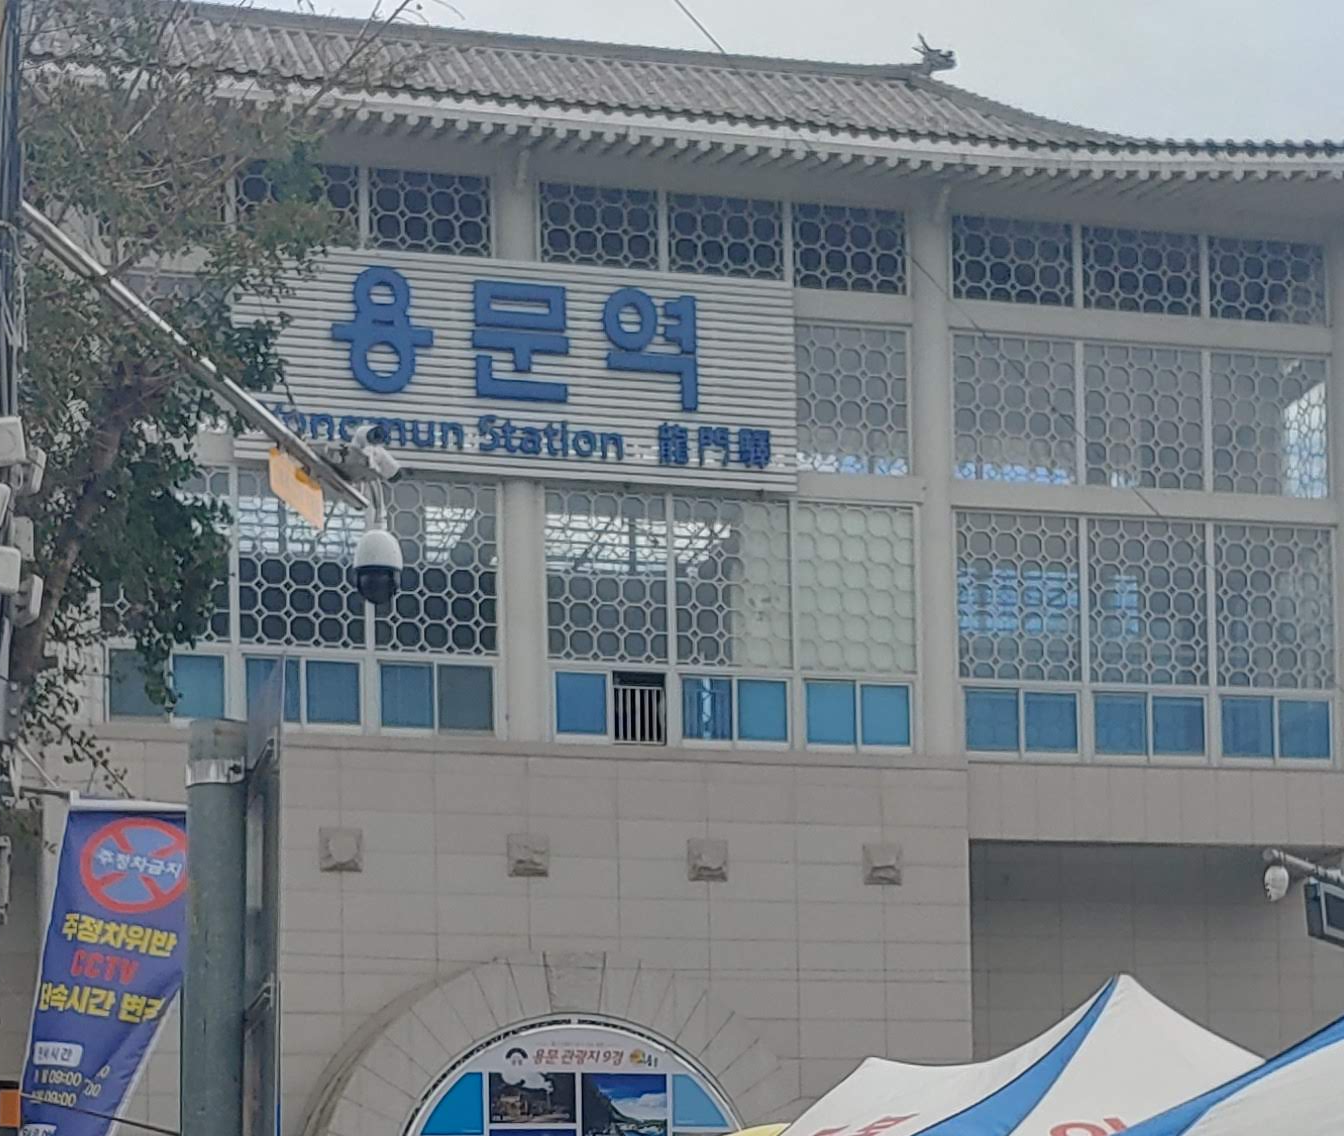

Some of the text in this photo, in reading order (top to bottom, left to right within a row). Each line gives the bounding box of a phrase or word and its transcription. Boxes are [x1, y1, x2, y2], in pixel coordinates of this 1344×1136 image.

[331, 265, 700, 413] 용문역
[478, 414, 625, 462] Station
[94, 848, 182, 879] 주정차금지
[62, 913, 179, 958] 주정차위반
[69, 947, 140, 985] CCTV
